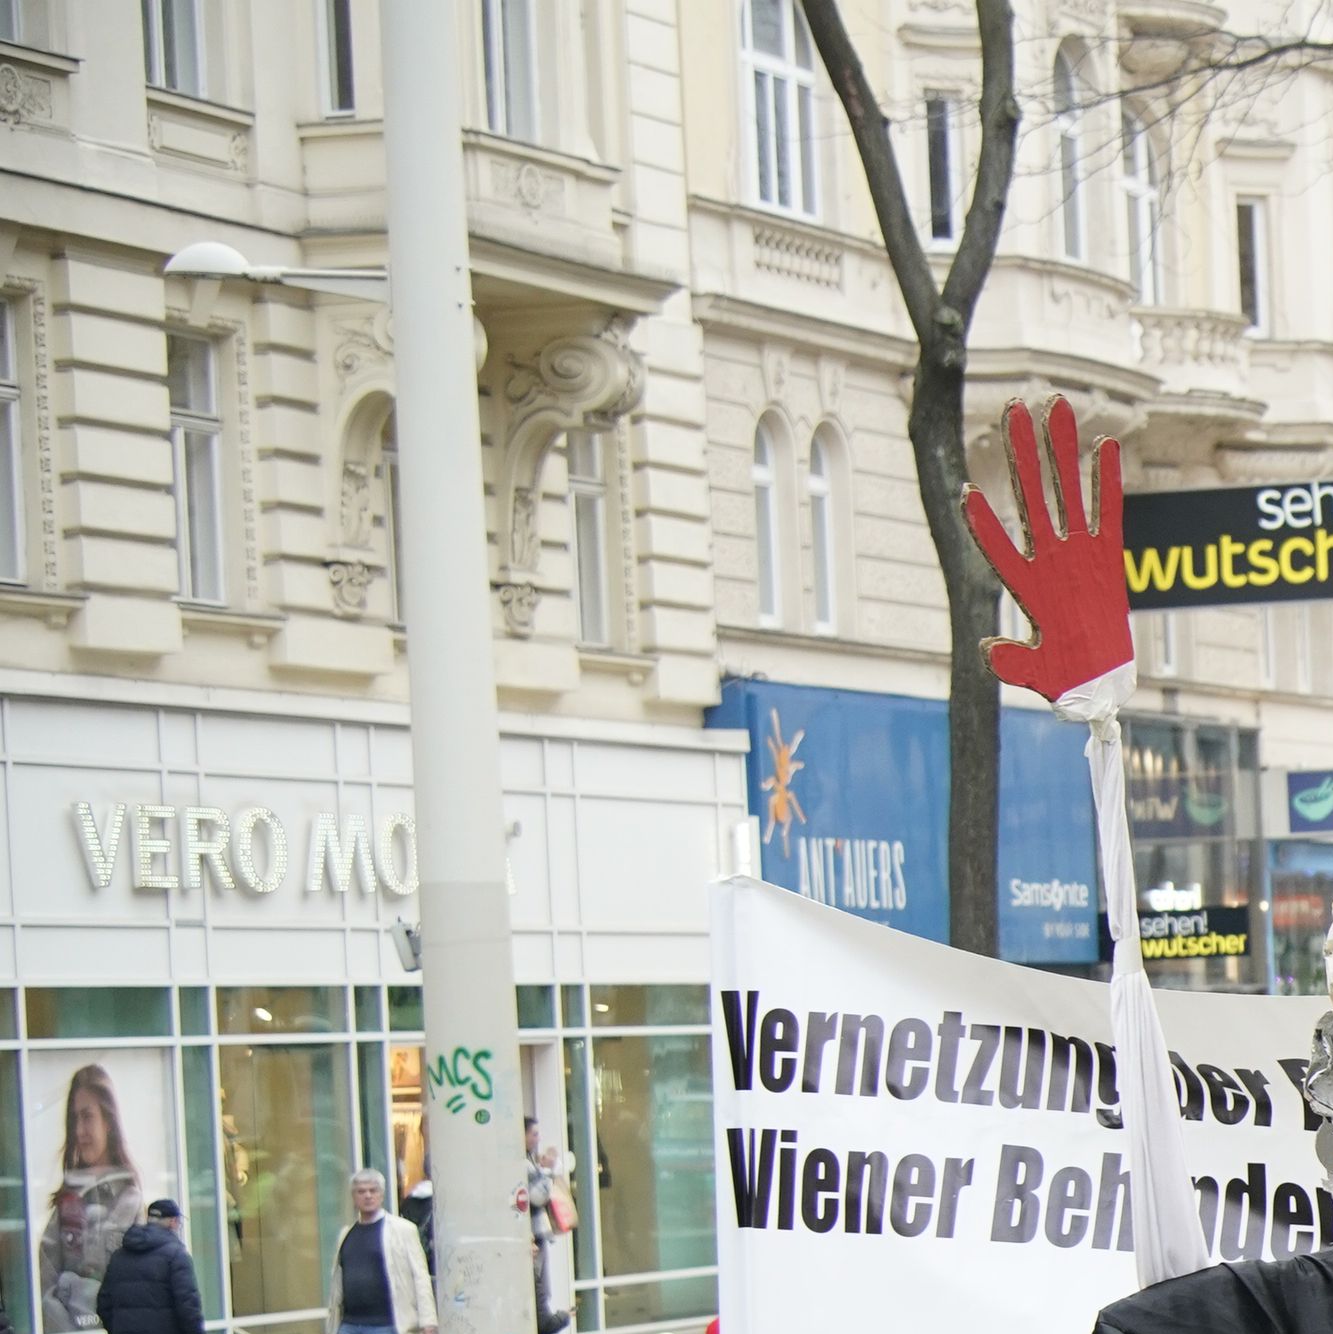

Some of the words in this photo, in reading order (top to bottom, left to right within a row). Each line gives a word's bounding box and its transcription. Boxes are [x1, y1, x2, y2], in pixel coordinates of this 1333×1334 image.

[74, 801, 289, 894] VERO
[1141, 911, 1208, 938] sehen!
[1142, 933, 1247, 959] wutscher
[426, 1046, 493, 1101] MCS
[721, 989, 1124, 1129] Vernetzung
[726, 1127, 974, 1240] Wiener
